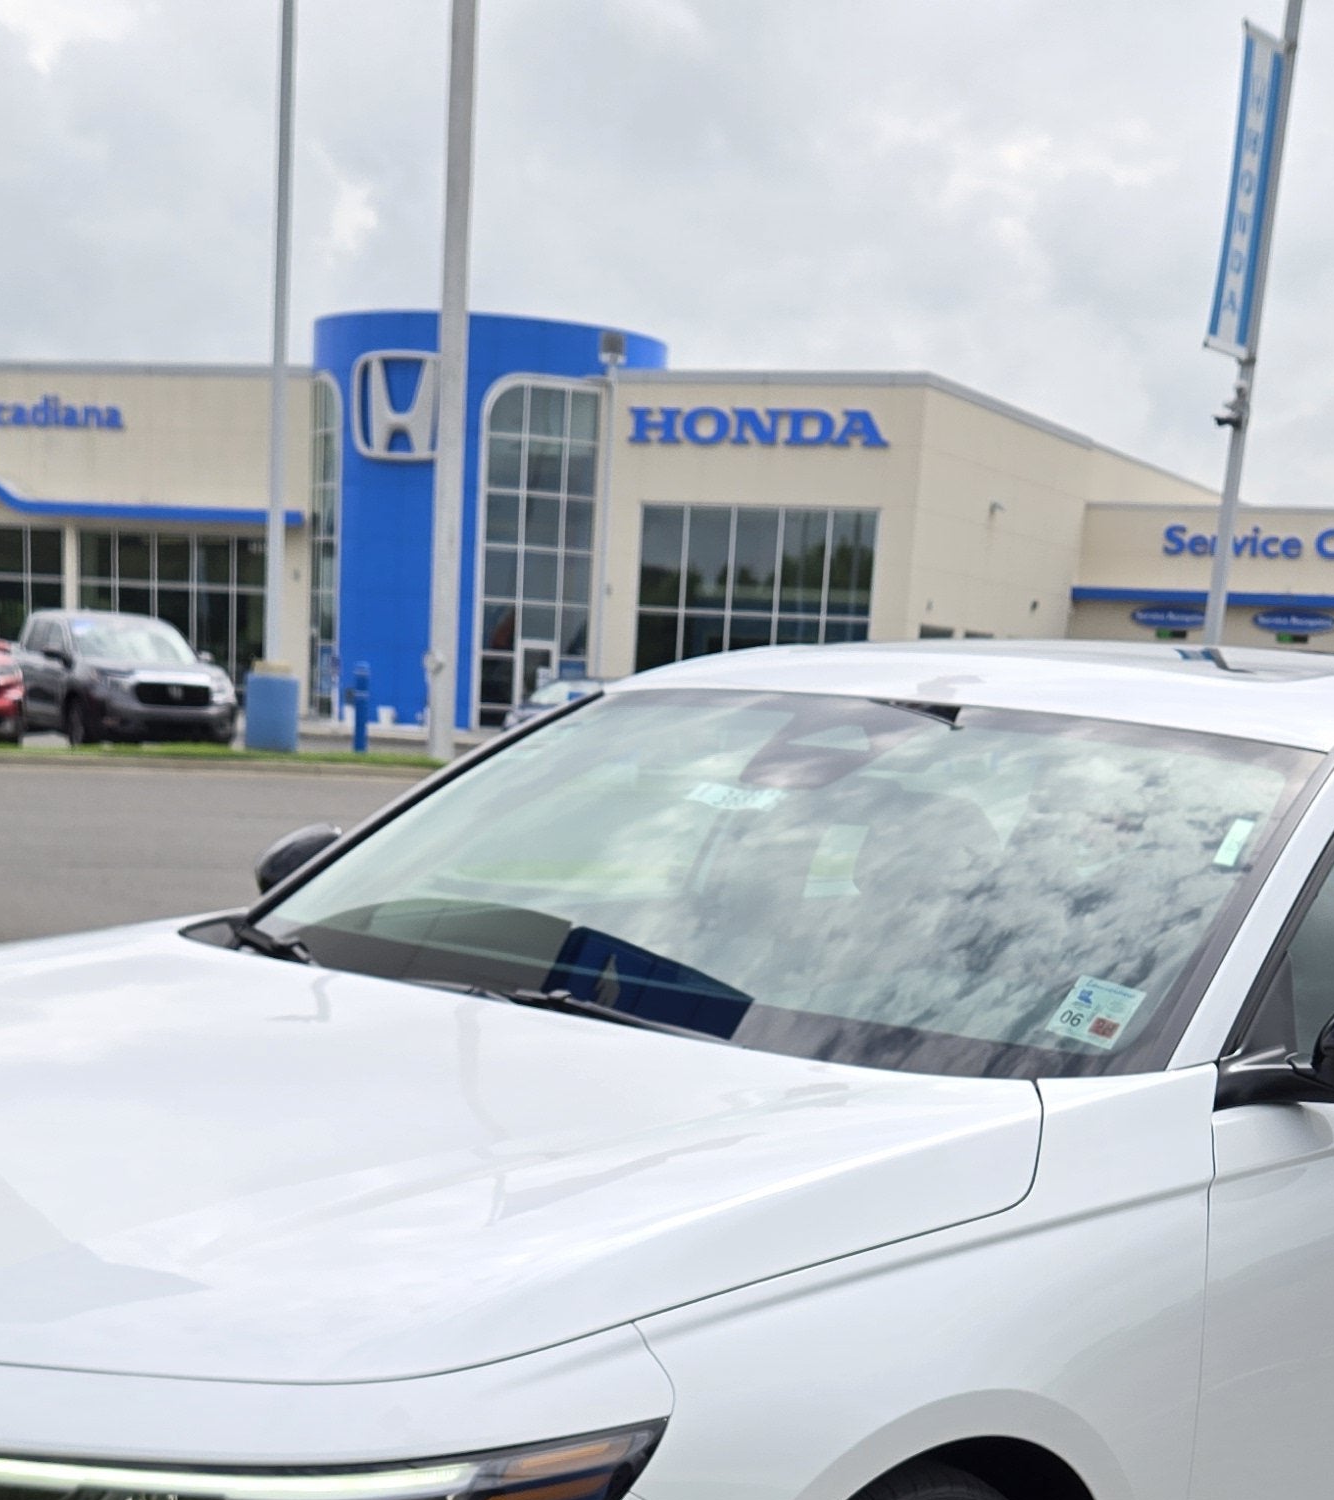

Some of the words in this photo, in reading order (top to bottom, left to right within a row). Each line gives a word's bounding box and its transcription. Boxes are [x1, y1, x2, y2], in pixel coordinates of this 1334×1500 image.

[628, 406, 889, 447] HONDA
[1163, 524, 1304, 559] Service
[1059, 1009, 1085, 1027] 06
